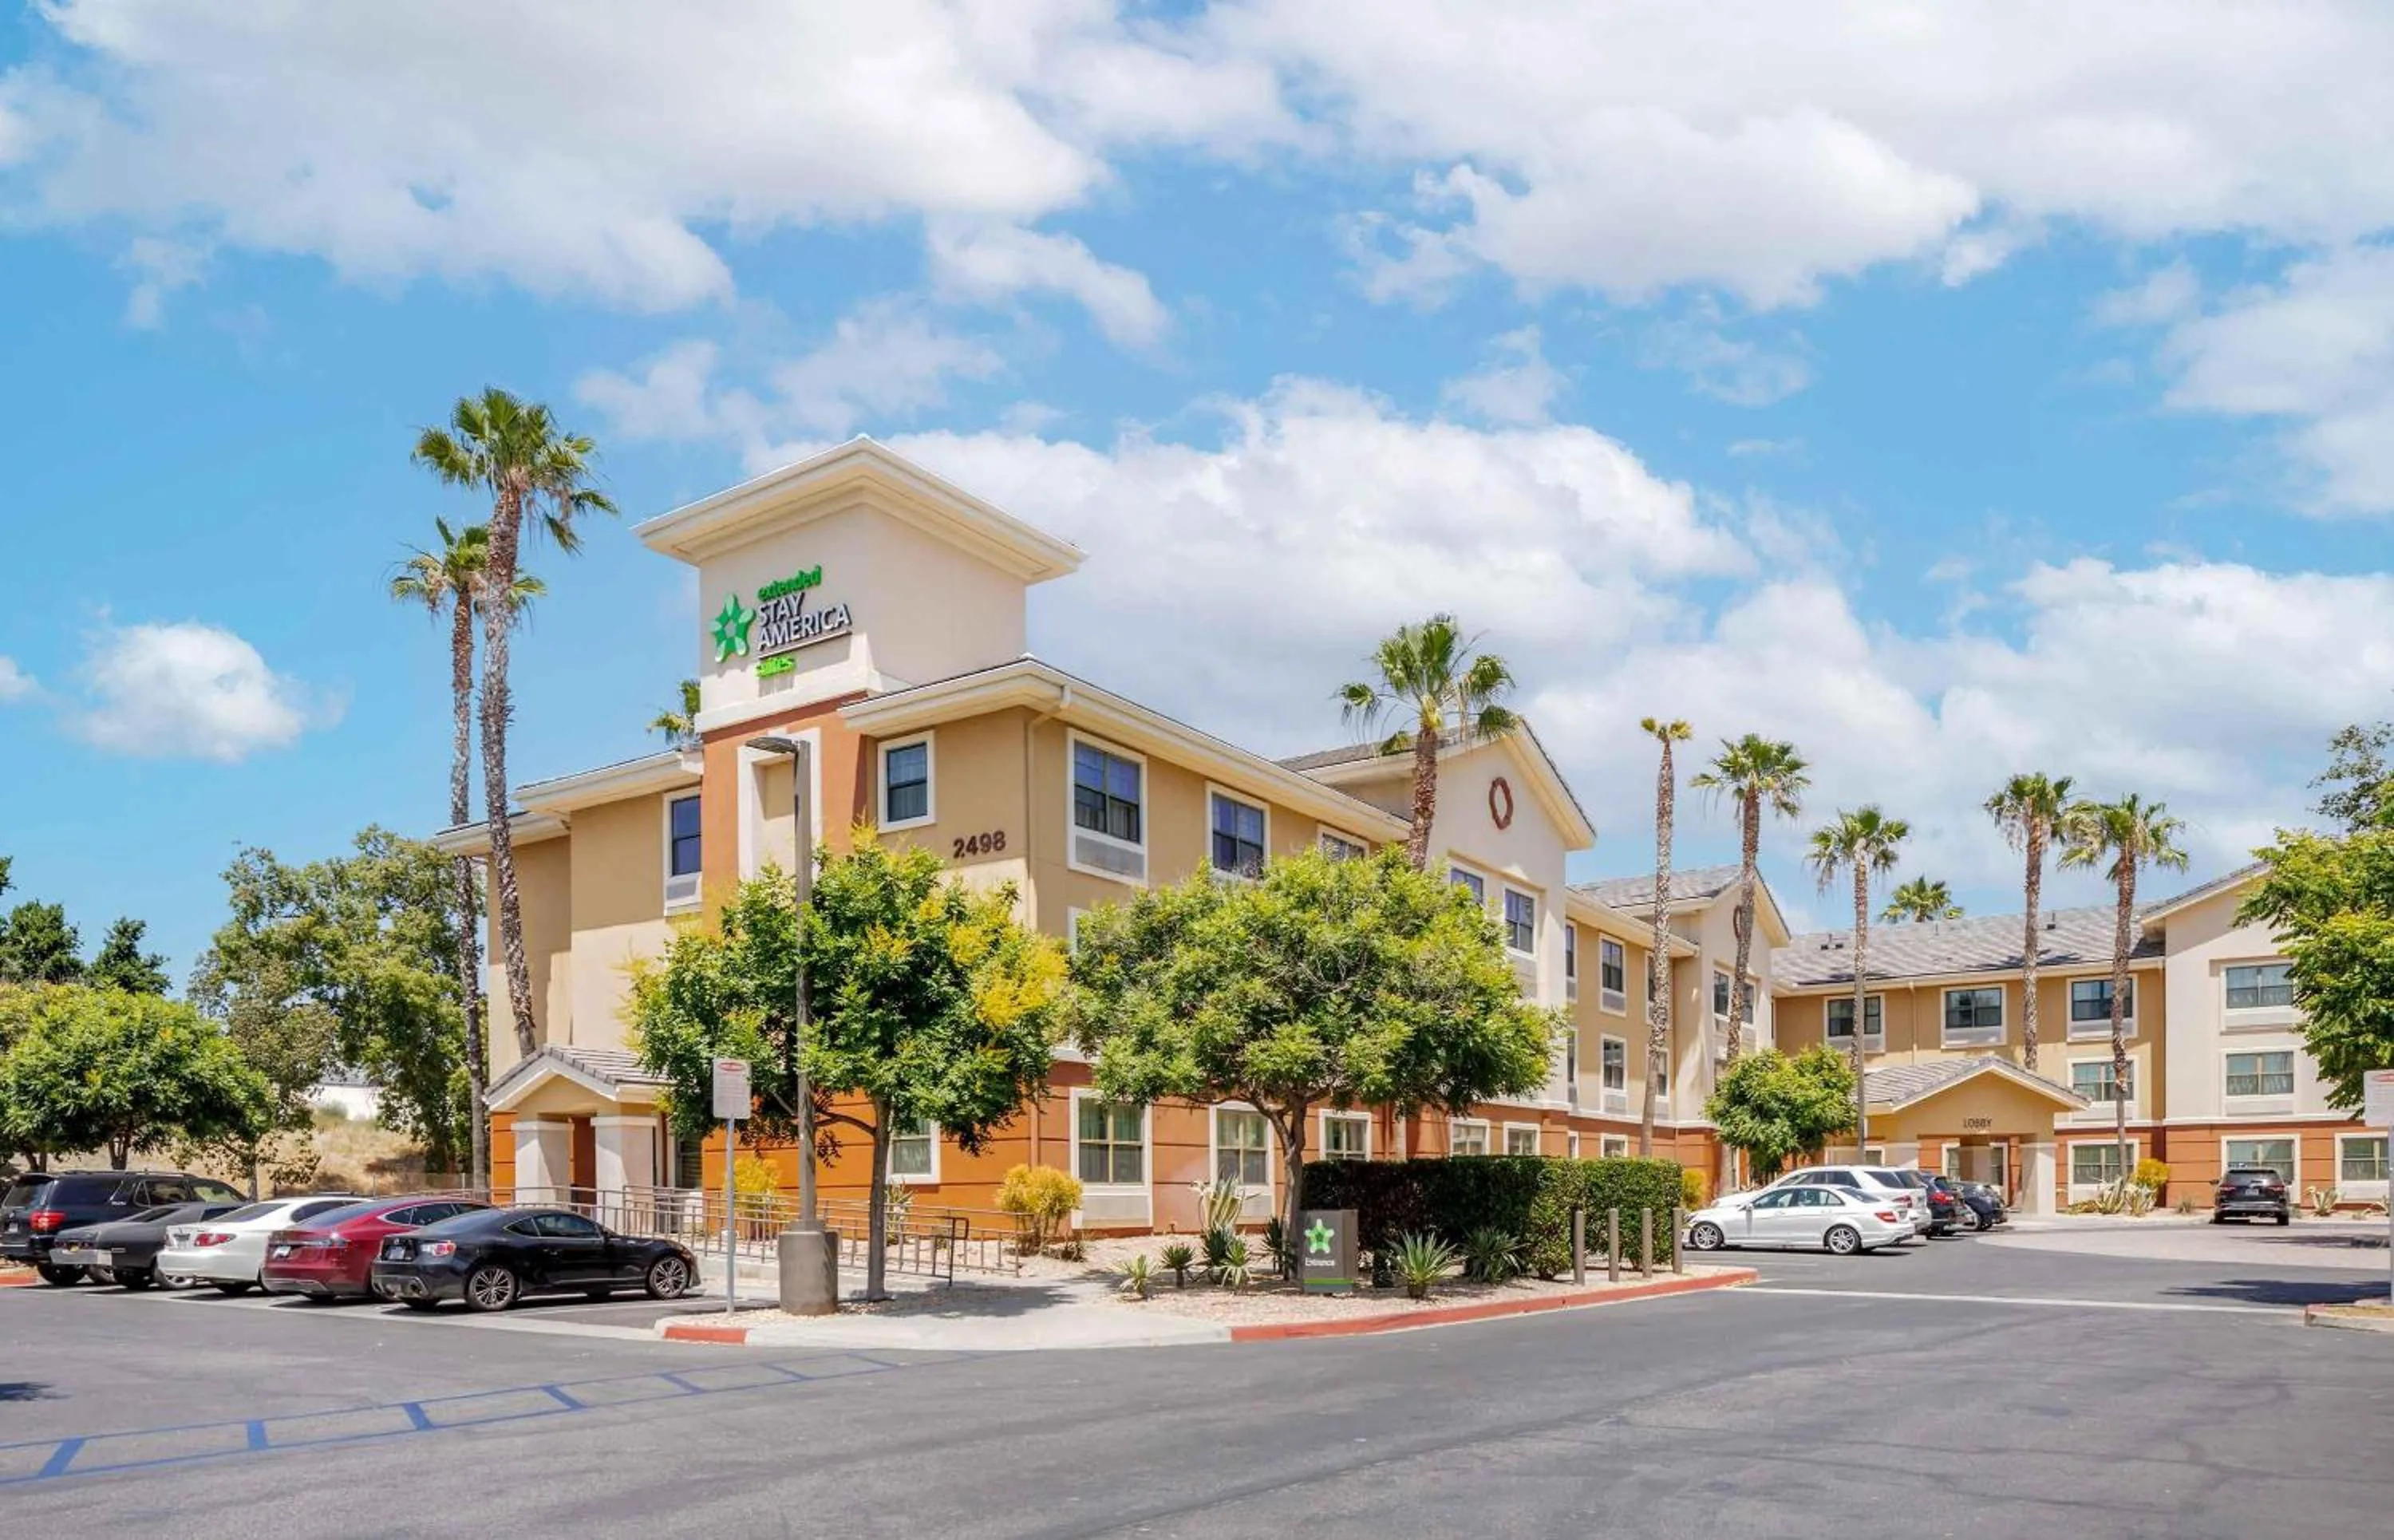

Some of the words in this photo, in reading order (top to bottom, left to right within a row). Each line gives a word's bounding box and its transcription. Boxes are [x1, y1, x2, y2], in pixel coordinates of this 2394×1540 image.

[757, 564, 822, 602] extended
[758, 592, 805, 626] STAY
[758, 603, 852, 651] AMERICA
[953, 830, 1006, 859] 2498
[1963, 1117, 1992, 1128] LOBBY
